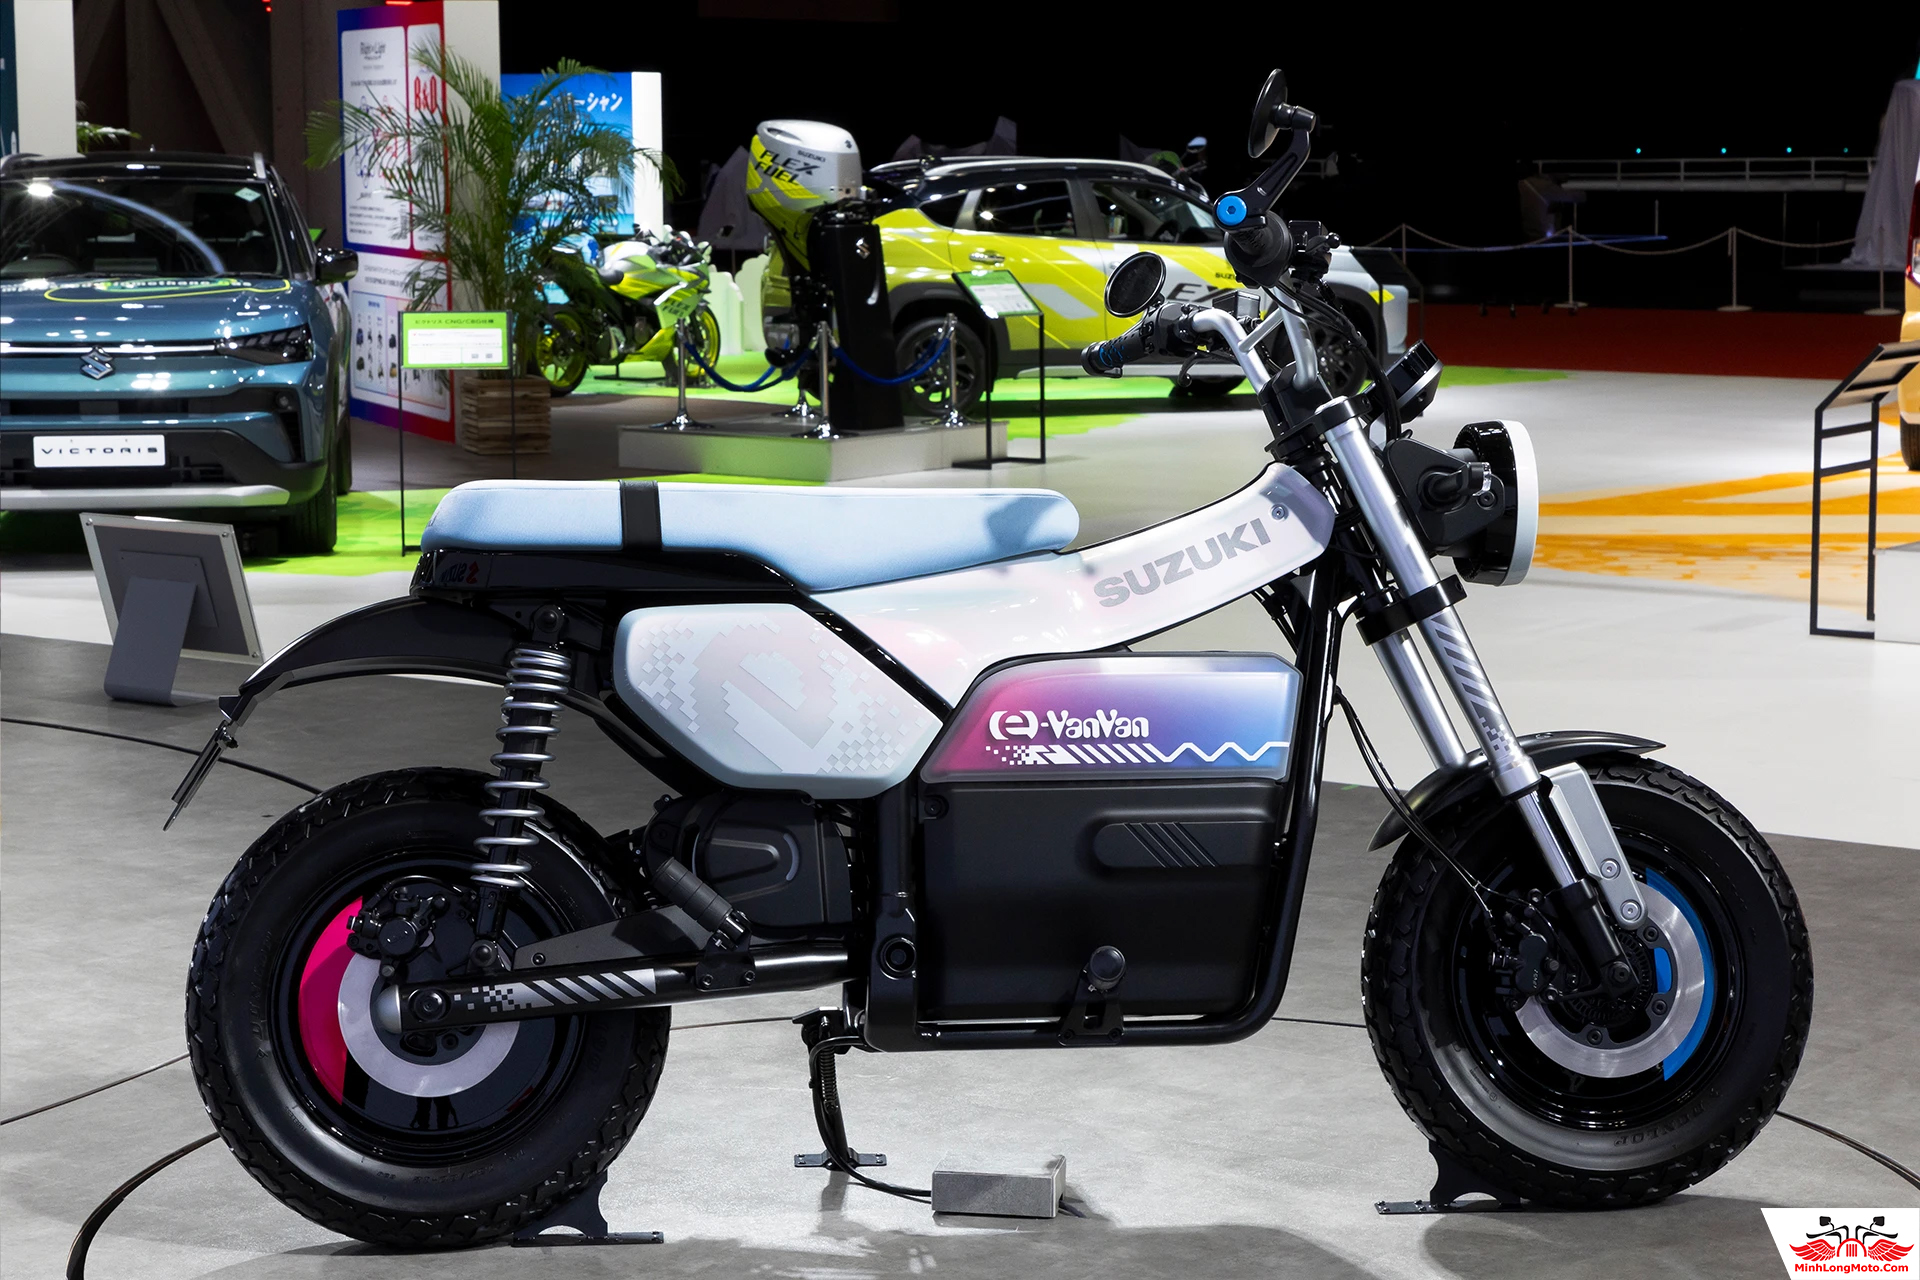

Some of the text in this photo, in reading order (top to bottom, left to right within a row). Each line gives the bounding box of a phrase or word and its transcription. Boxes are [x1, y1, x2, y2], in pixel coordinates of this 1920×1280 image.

[760, 150, 820, 176] FLEX
[797, 150, 826, 163] SUZUKI
[755, 161, 799, 186] FUEL
[1093, 517, 1271, 608] SUZUKI
